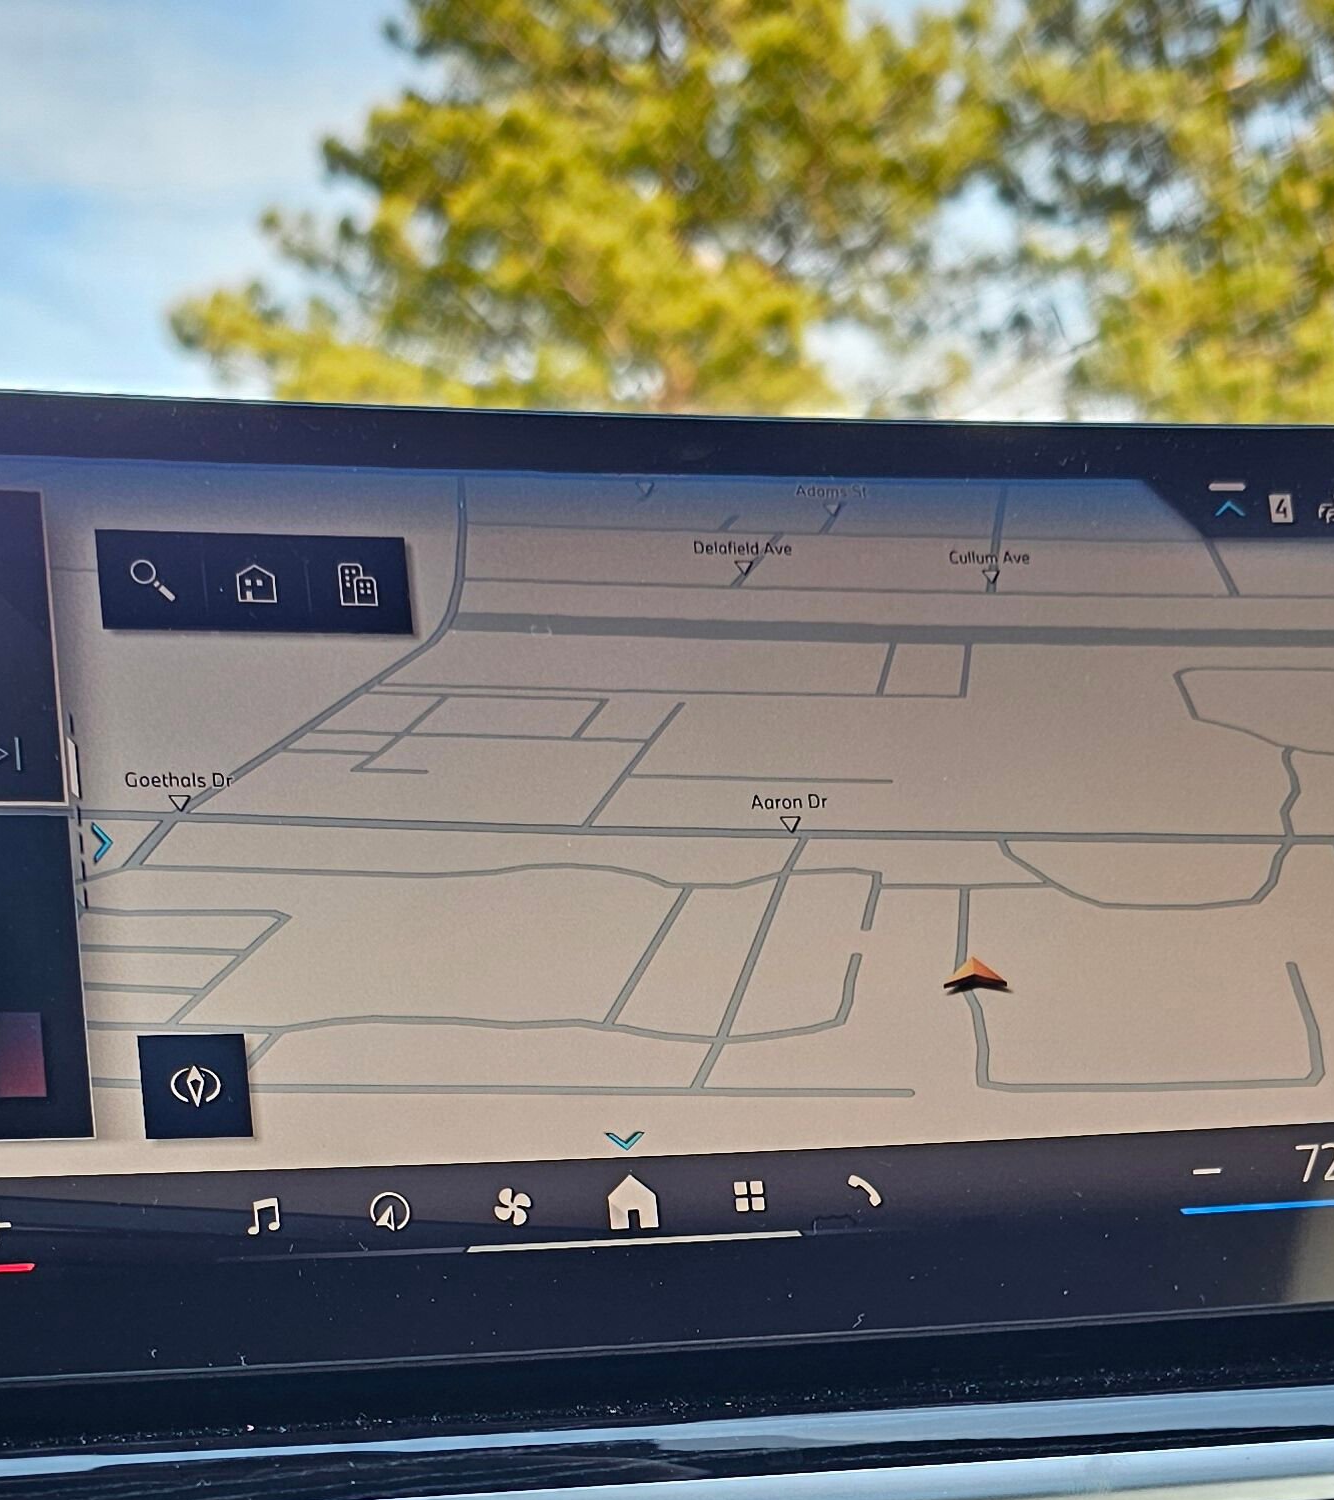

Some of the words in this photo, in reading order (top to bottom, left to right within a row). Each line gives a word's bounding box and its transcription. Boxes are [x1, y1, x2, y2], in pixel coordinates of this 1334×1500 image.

[795, 484, 848, 498] Adams
[693, 540, 759, 556] Delafield
[764, 541, 793, 556] Ave
[949, 550, 998, 566] Cullum
[1003, 551, 1031, 566] Ave
[124, 772, 207, 789] Goethals
[211, 773, 233, 788] Dr
[751, 794, 803, 810] Aaron
[807, 794, 828, 809] Dr
